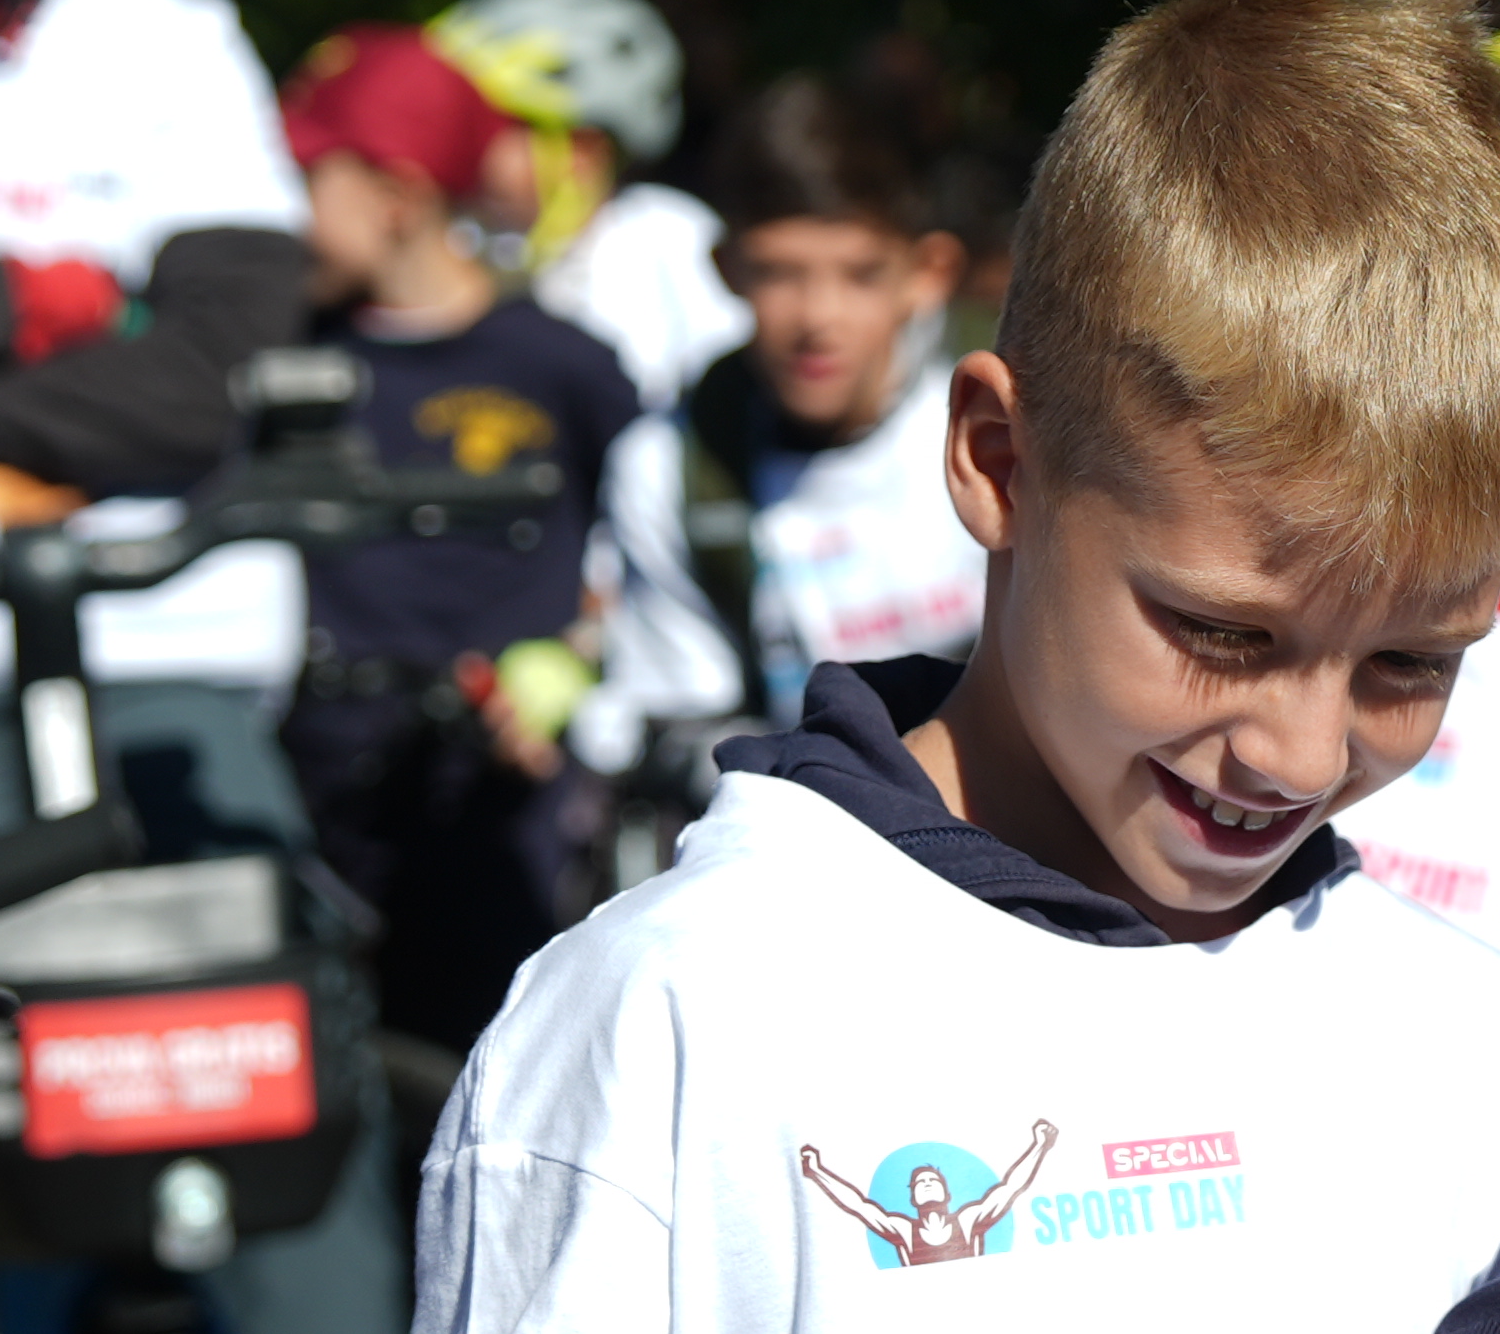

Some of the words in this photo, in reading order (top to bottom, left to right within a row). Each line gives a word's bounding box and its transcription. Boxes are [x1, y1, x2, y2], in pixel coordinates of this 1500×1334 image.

[1112, 1138, 1233, 1172] SPECIAL
[1031, 1184, 1158, 1246] SPORT
[1169, 1173, 1246, 1230] DAY
